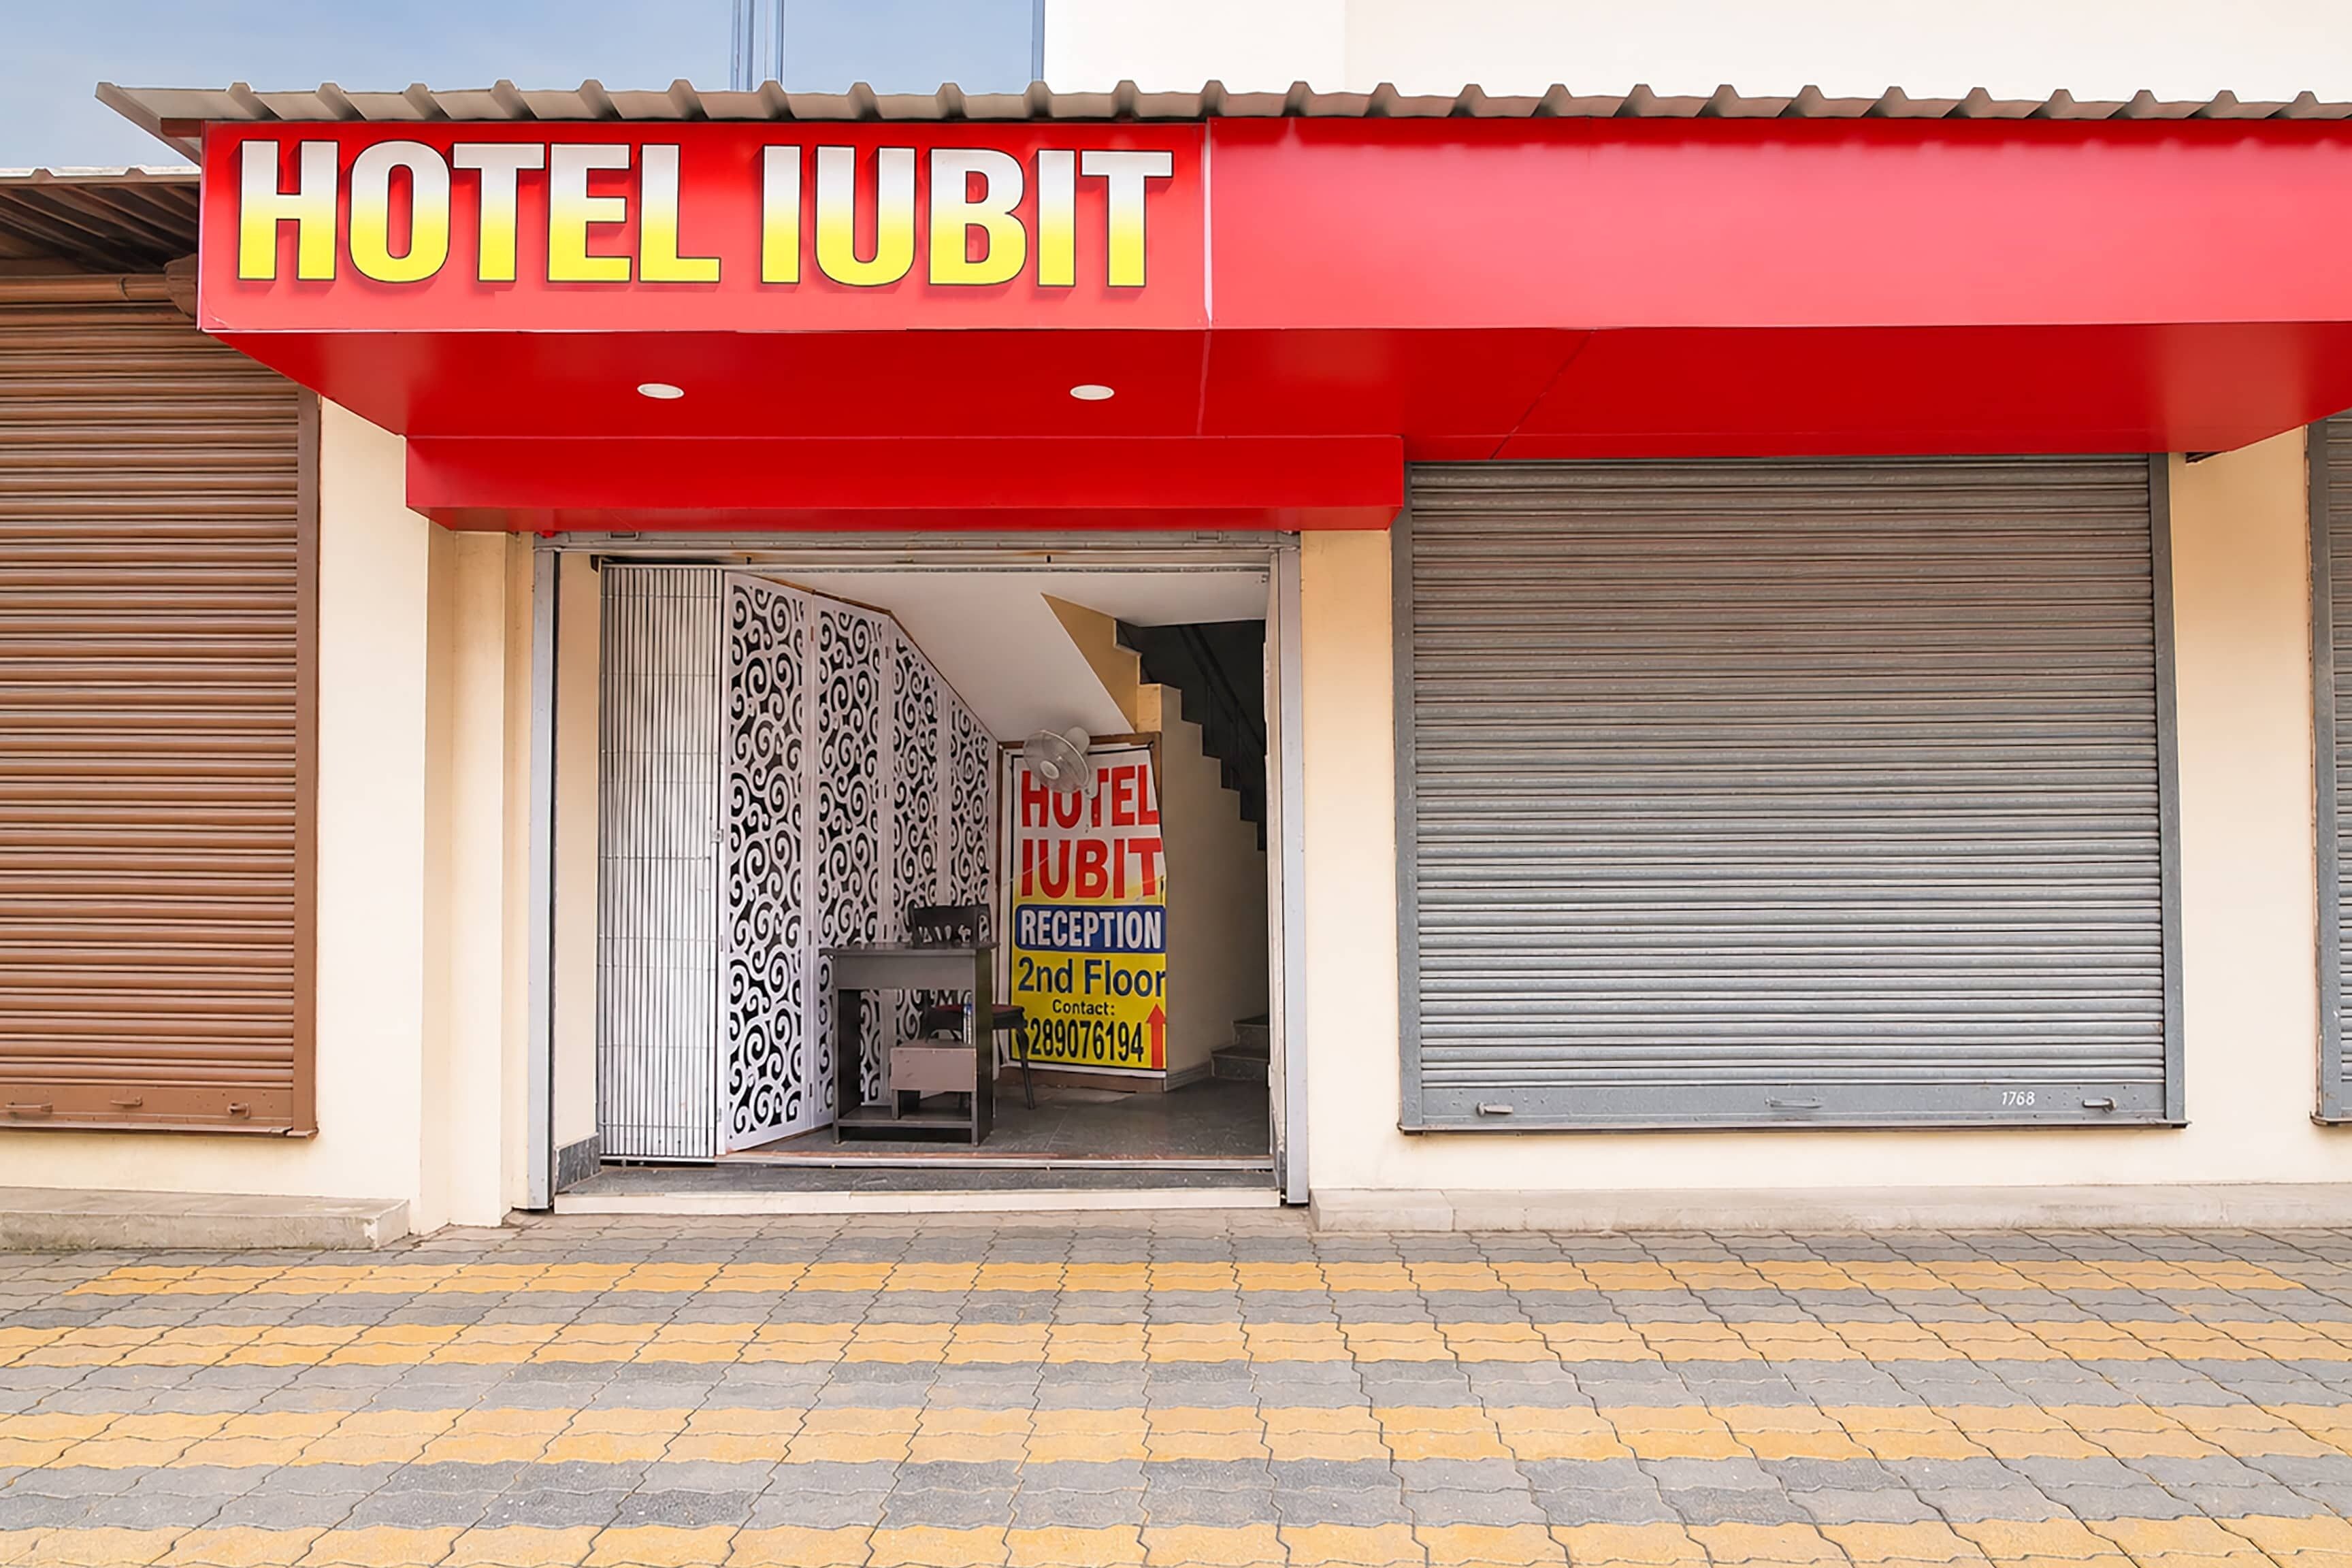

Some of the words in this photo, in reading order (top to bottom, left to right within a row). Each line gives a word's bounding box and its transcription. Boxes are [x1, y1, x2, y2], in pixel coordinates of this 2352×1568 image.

[238, 140, 720, 282] HOTEL
[761, 144, 1173, 287] IUBIT
[1022, 838, 1162, 898] IUBIT
[1022, 911, 1160, 949] RECEPTION
[1019, 957, 1073, 994] 2nd
[1085, 960, 1165, 997] Floor
[1052, 999, 1115, 1016] Contact:
[1017, 1018, 1143, 1062] 289076194
[2002, 1091, 2036, 1106] 1768
